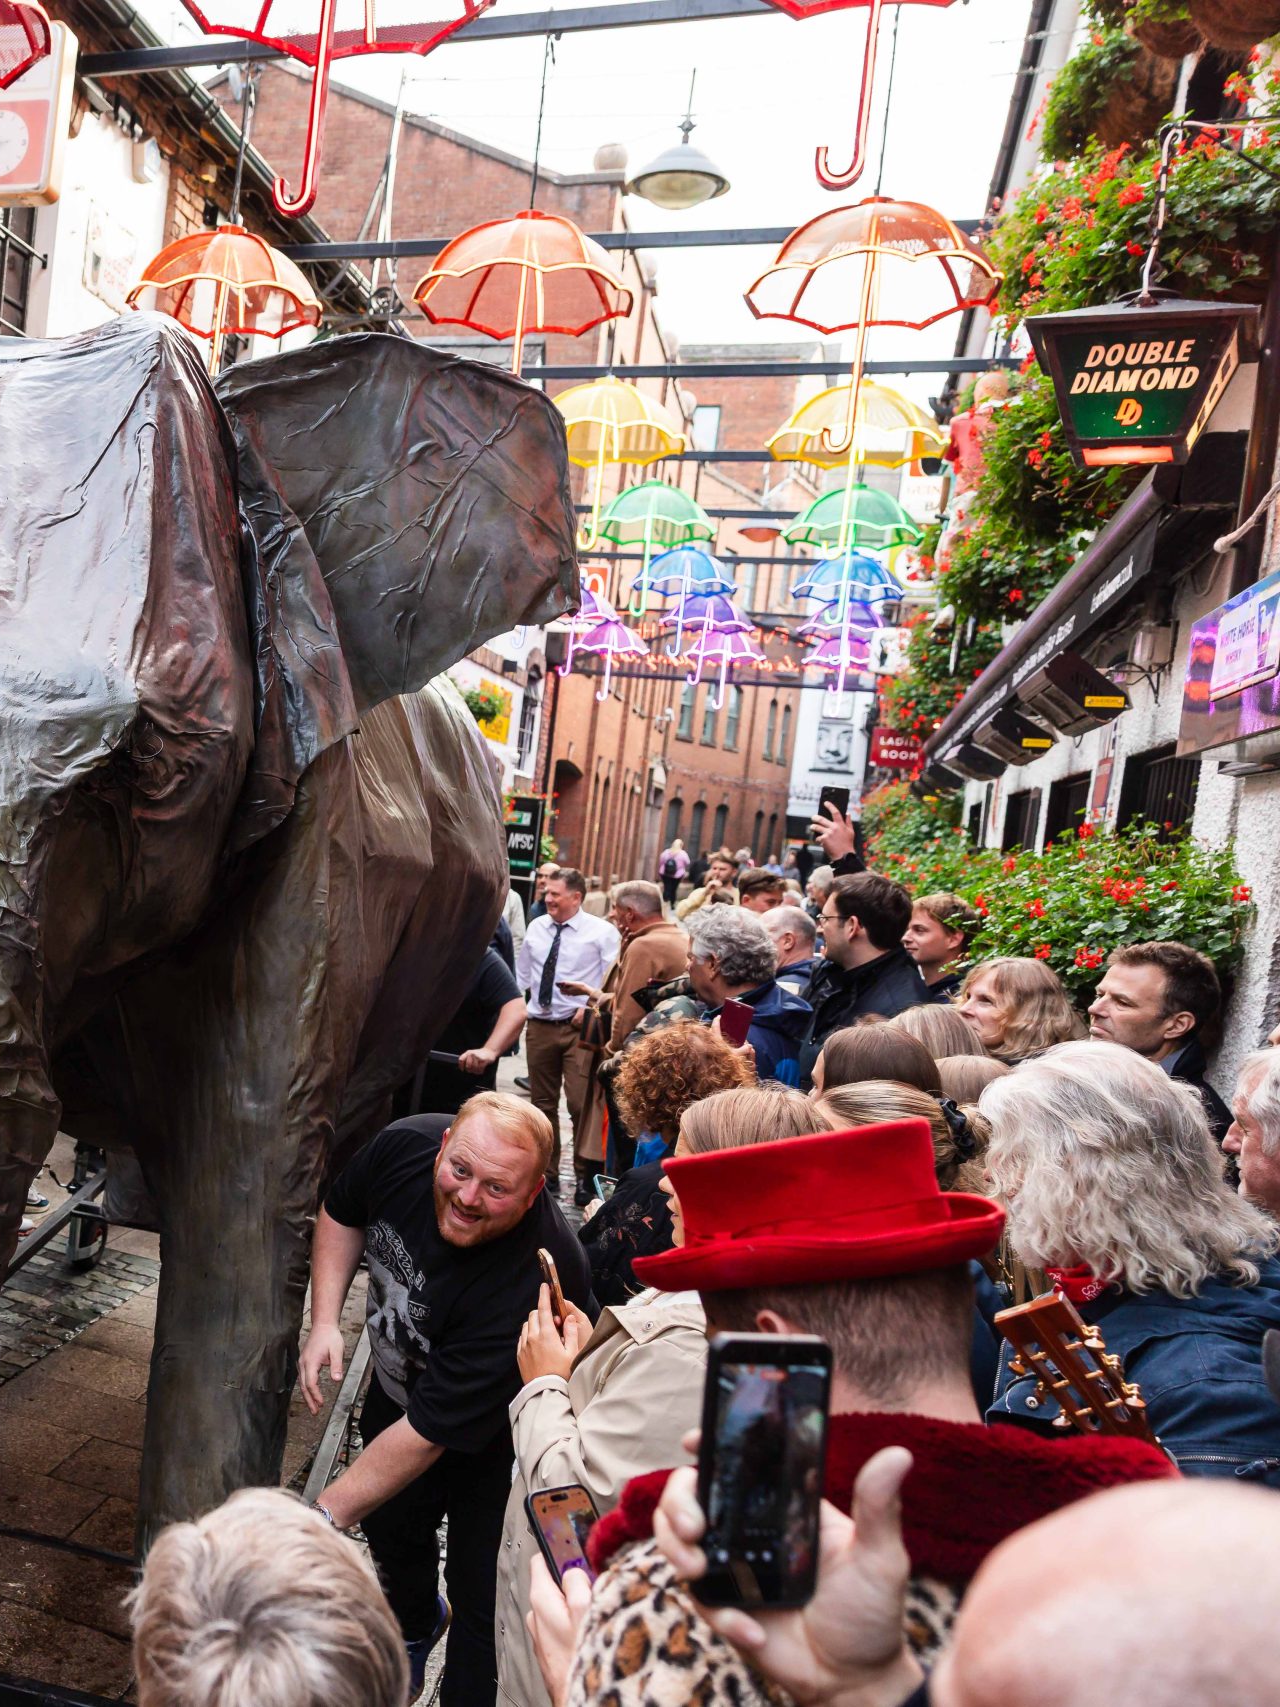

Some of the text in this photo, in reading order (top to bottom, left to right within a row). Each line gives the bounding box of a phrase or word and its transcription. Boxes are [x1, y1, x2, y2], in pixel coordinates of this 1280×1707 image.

[1084, 339, 1196, 368] DOUBLE
[1069, 366, 1200, 394] DIAMOND
[880, 748, 919, 760] ROOM
